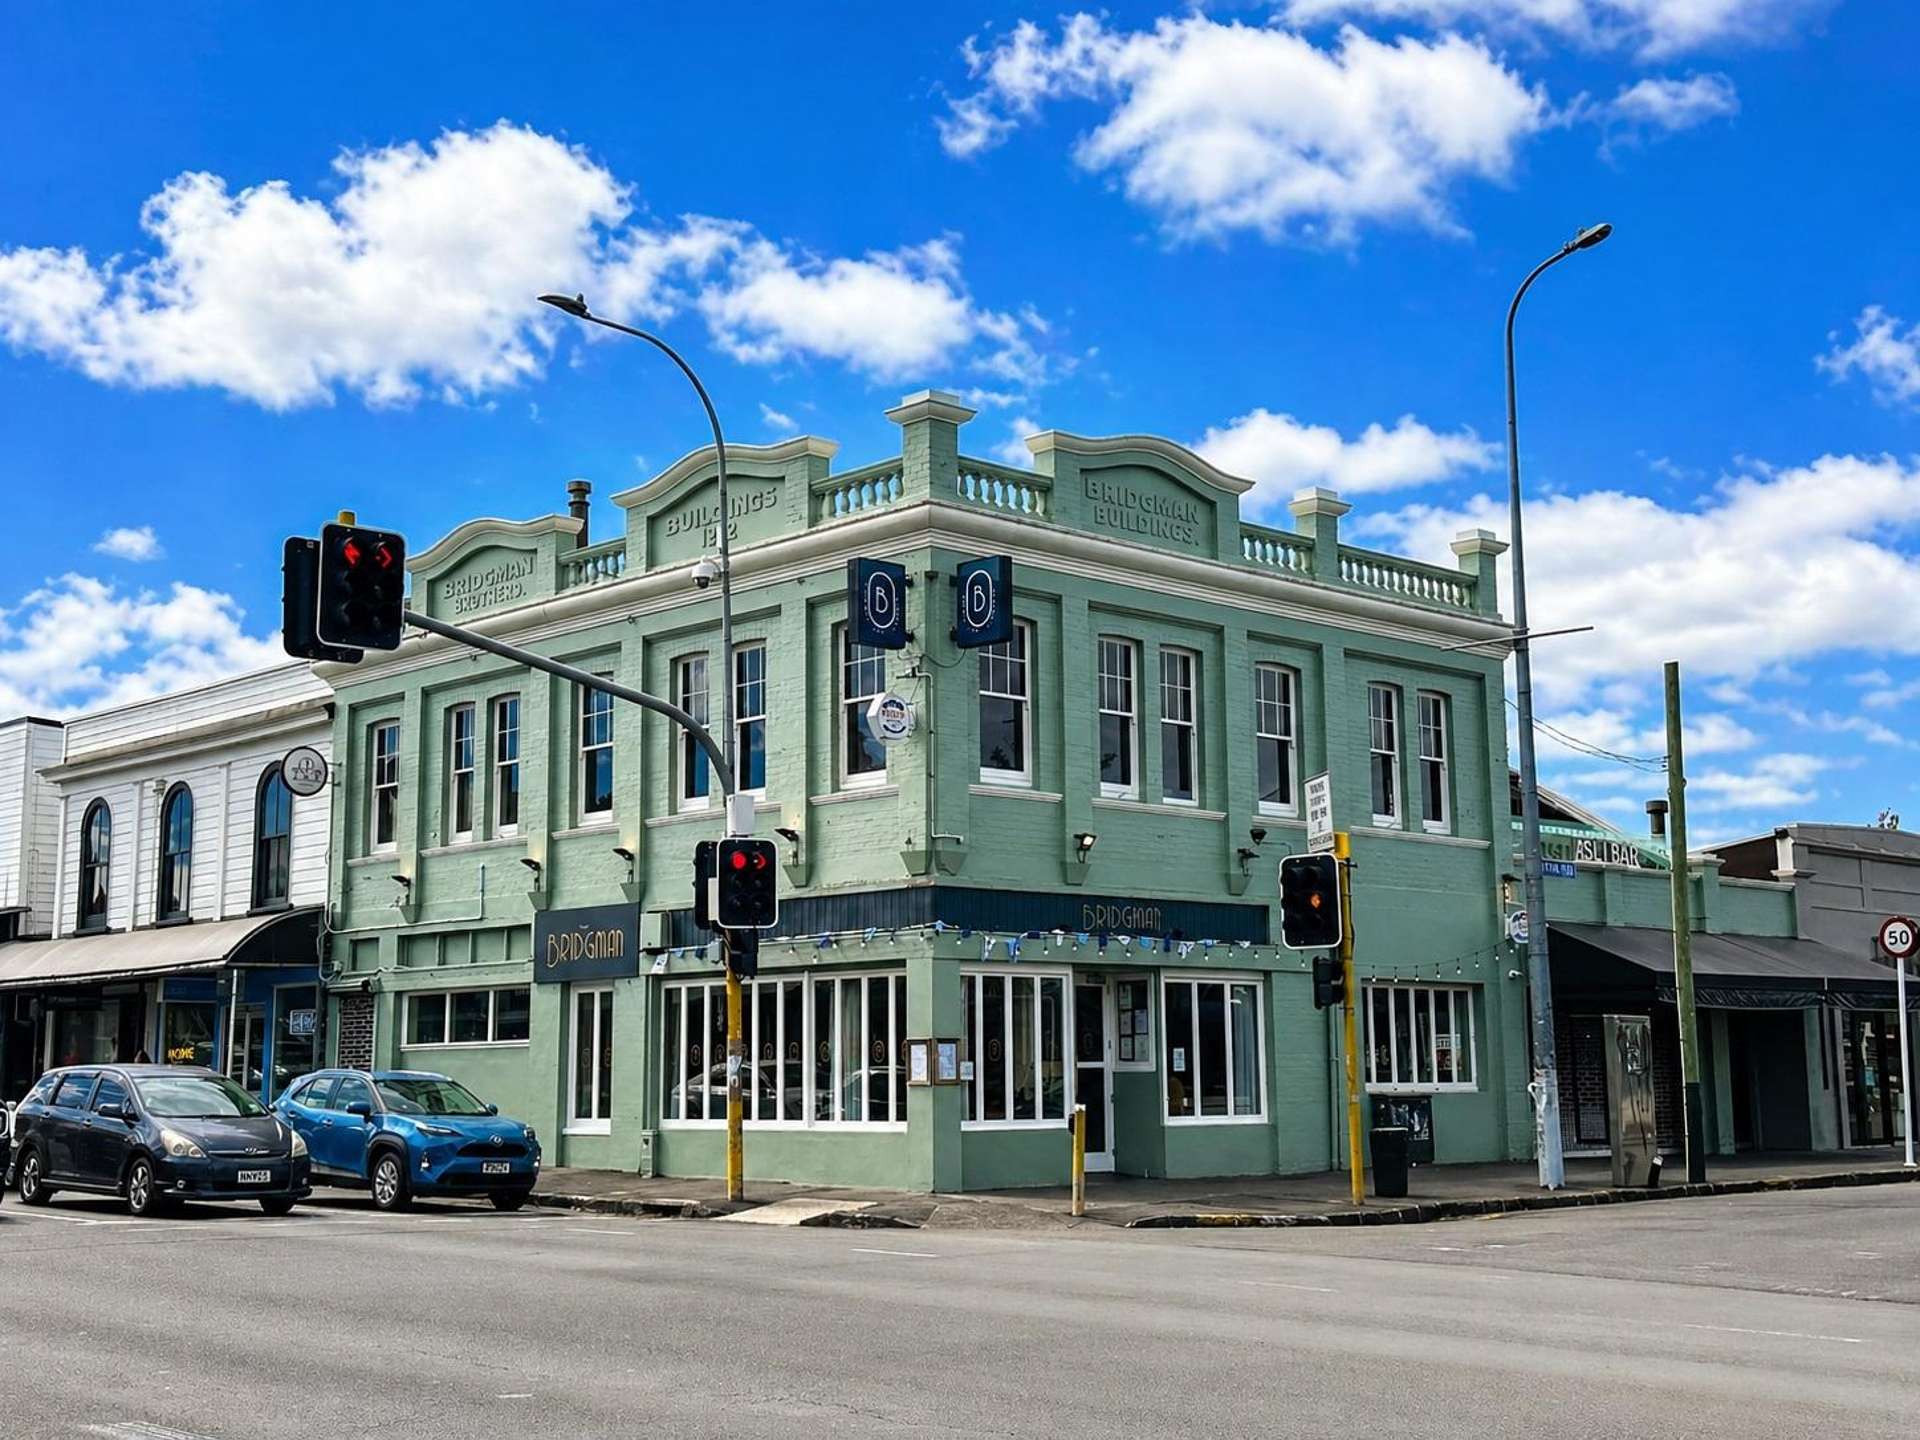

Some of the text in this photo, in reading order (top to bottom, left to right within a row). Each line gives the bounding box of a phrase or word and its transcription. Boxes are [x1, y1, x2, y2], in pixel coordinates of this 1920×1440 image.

[1085, 477, 1200, 525] BRIDGMAN
[702, 521, 738, 549] 192
[444, 555, 534, 600] BRIDGMAN
[1611, 842, 1641, 869] BAR
[1083, 903, 1161, 931] BRIDGMAN
[546, 929, 624, 968] BRIDGMAN
[1888, 930, 1910, 946] 50
